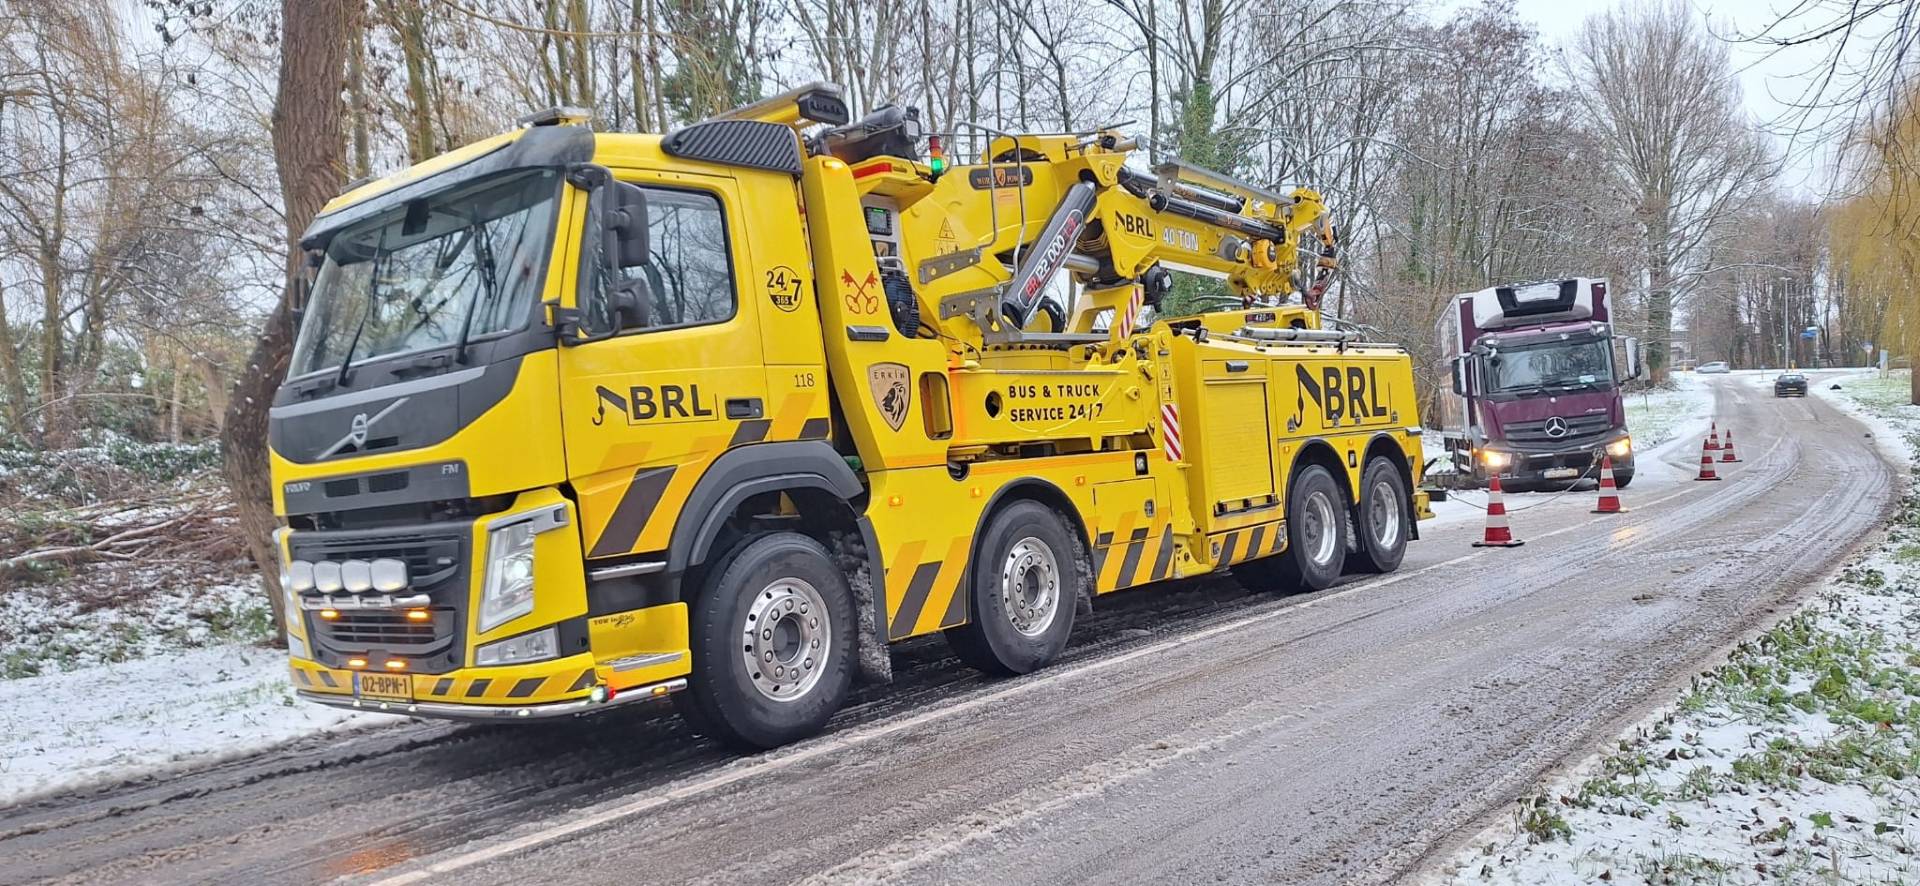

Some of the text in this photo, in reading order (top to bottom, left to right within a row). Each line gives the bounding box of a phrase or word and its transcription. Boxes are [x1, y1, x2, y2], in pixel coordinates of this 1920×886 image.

[1125, 214, 1154, 237] BRL
[1163, 227, 1199, 251] 40 TON
[766, 270, 802, 302] 24 7
[775, 295, 790, 305] 365
[794, 372, 815, 388] 118
[1008, 384, 1100, 398] BUS & TRUCK
[1322, 366, 1387, 420] BRL
[629, 384, 713, 420] BRL
[1010, 402, 1103, 422] SERVICE 24/7
[442, 463, 459, 475] FM
[284, 481, 311, 494] VOLVO
[361, 675, 408, 695] 02-BPN-1
